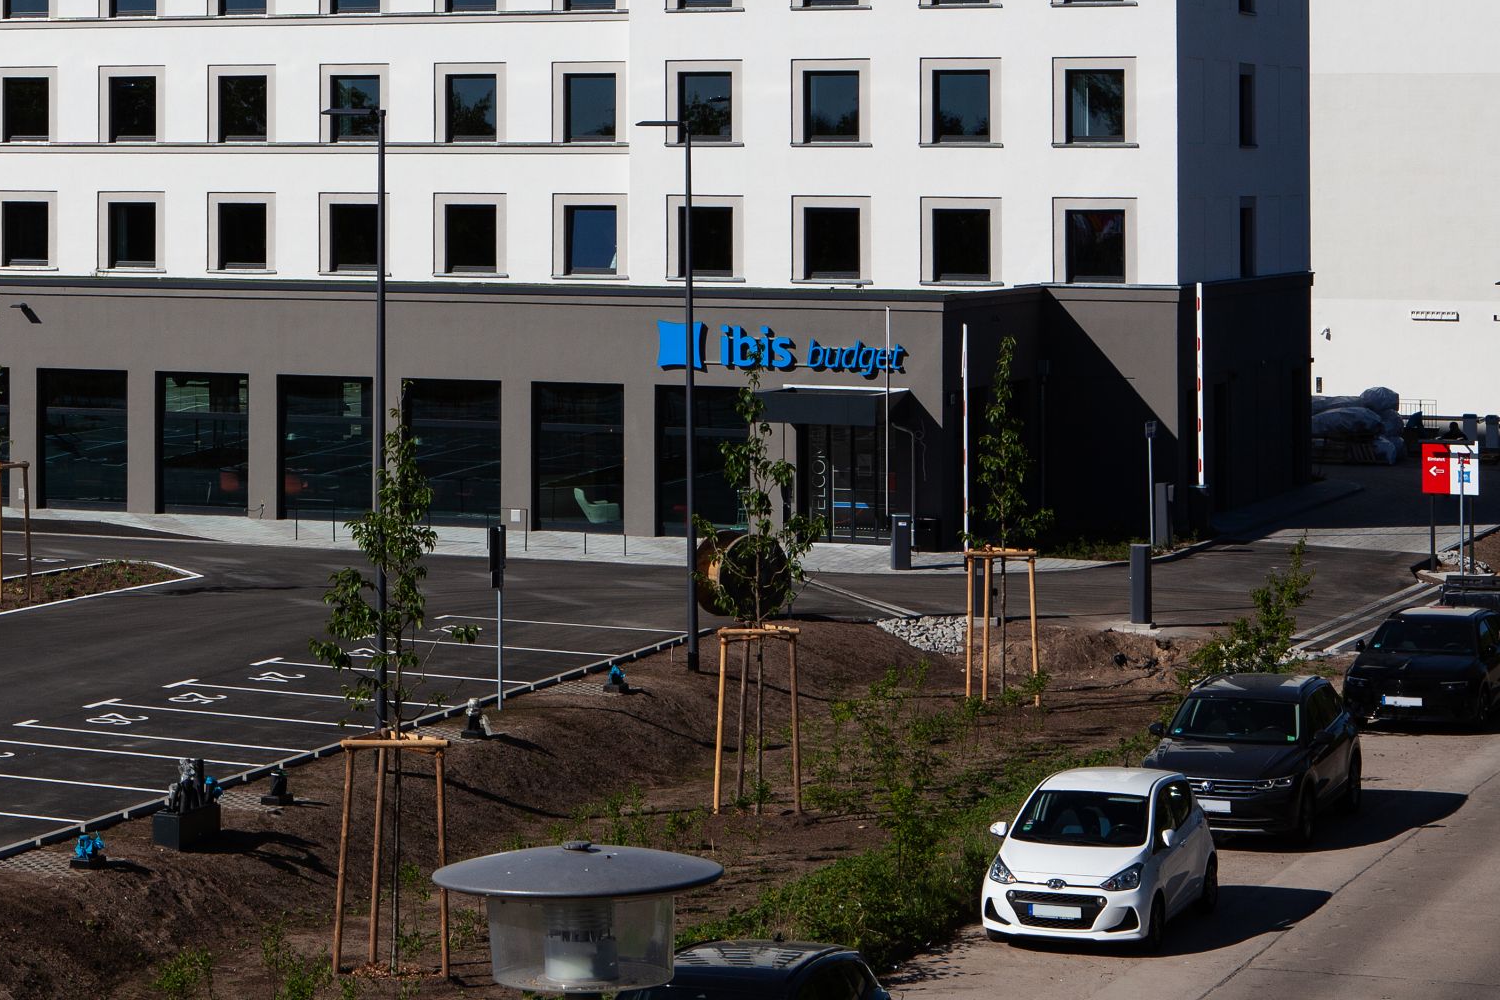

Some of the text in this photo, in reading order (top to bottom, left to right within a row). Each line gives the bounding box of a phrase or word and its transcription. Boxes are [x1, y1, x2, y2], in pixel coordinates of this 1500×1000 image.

[719, 324, 904, 376] ibis budget
[248, 671, 306, 683] 24
[168, 691, 228, 705] 25
[85, 712, 149, 726] 26
